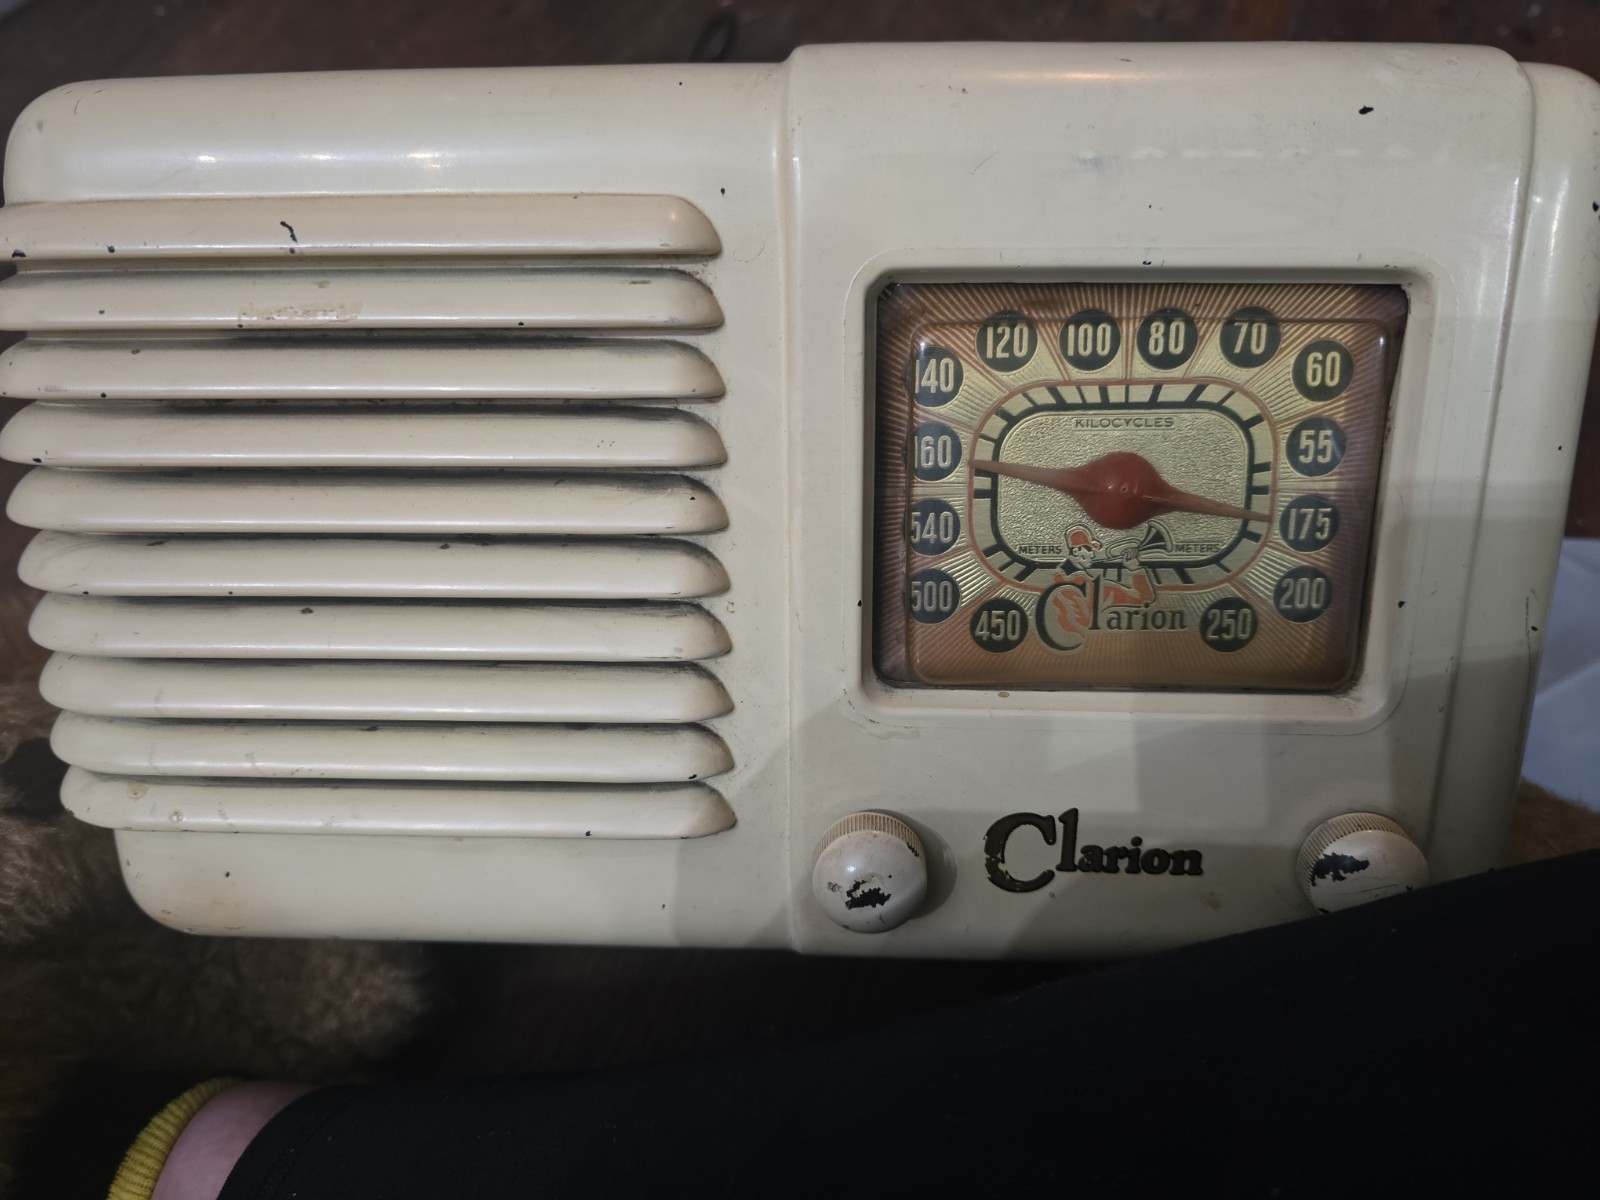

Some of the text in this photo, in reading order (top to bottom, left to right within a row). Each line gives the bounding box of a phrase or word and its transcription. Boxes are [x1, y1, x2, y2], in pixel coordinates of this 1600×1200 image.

[986, 322, 1029, 359] 120
[1067, 322, 1112, 357] 100
[1148, 320, 1186, 356] 80
[1233, 322, 1268, 355] 70
[915, 357, 955, 394] 140
[1306, 351, 1341, 387] 60
[1075, 418, 1174, 429] KILOCYCLES
[1299, 430, 1333, 464] 55
[911, 511, 954, 544] 540
[1287, 507, 1333, 541] 175
[1018, 545, 1062, 555] METERS
[1175, 543, 1221, 554] METERS
[911, 581, 953, 612] 500
[1279, 577, 1326, 610] 200
[975, 609, 1022, 641] 450
[1035, 576, 1187, 651] Clarion
[1205, 608, 1251, 641] 250
[983, 807, 1204, 893] Clarion
